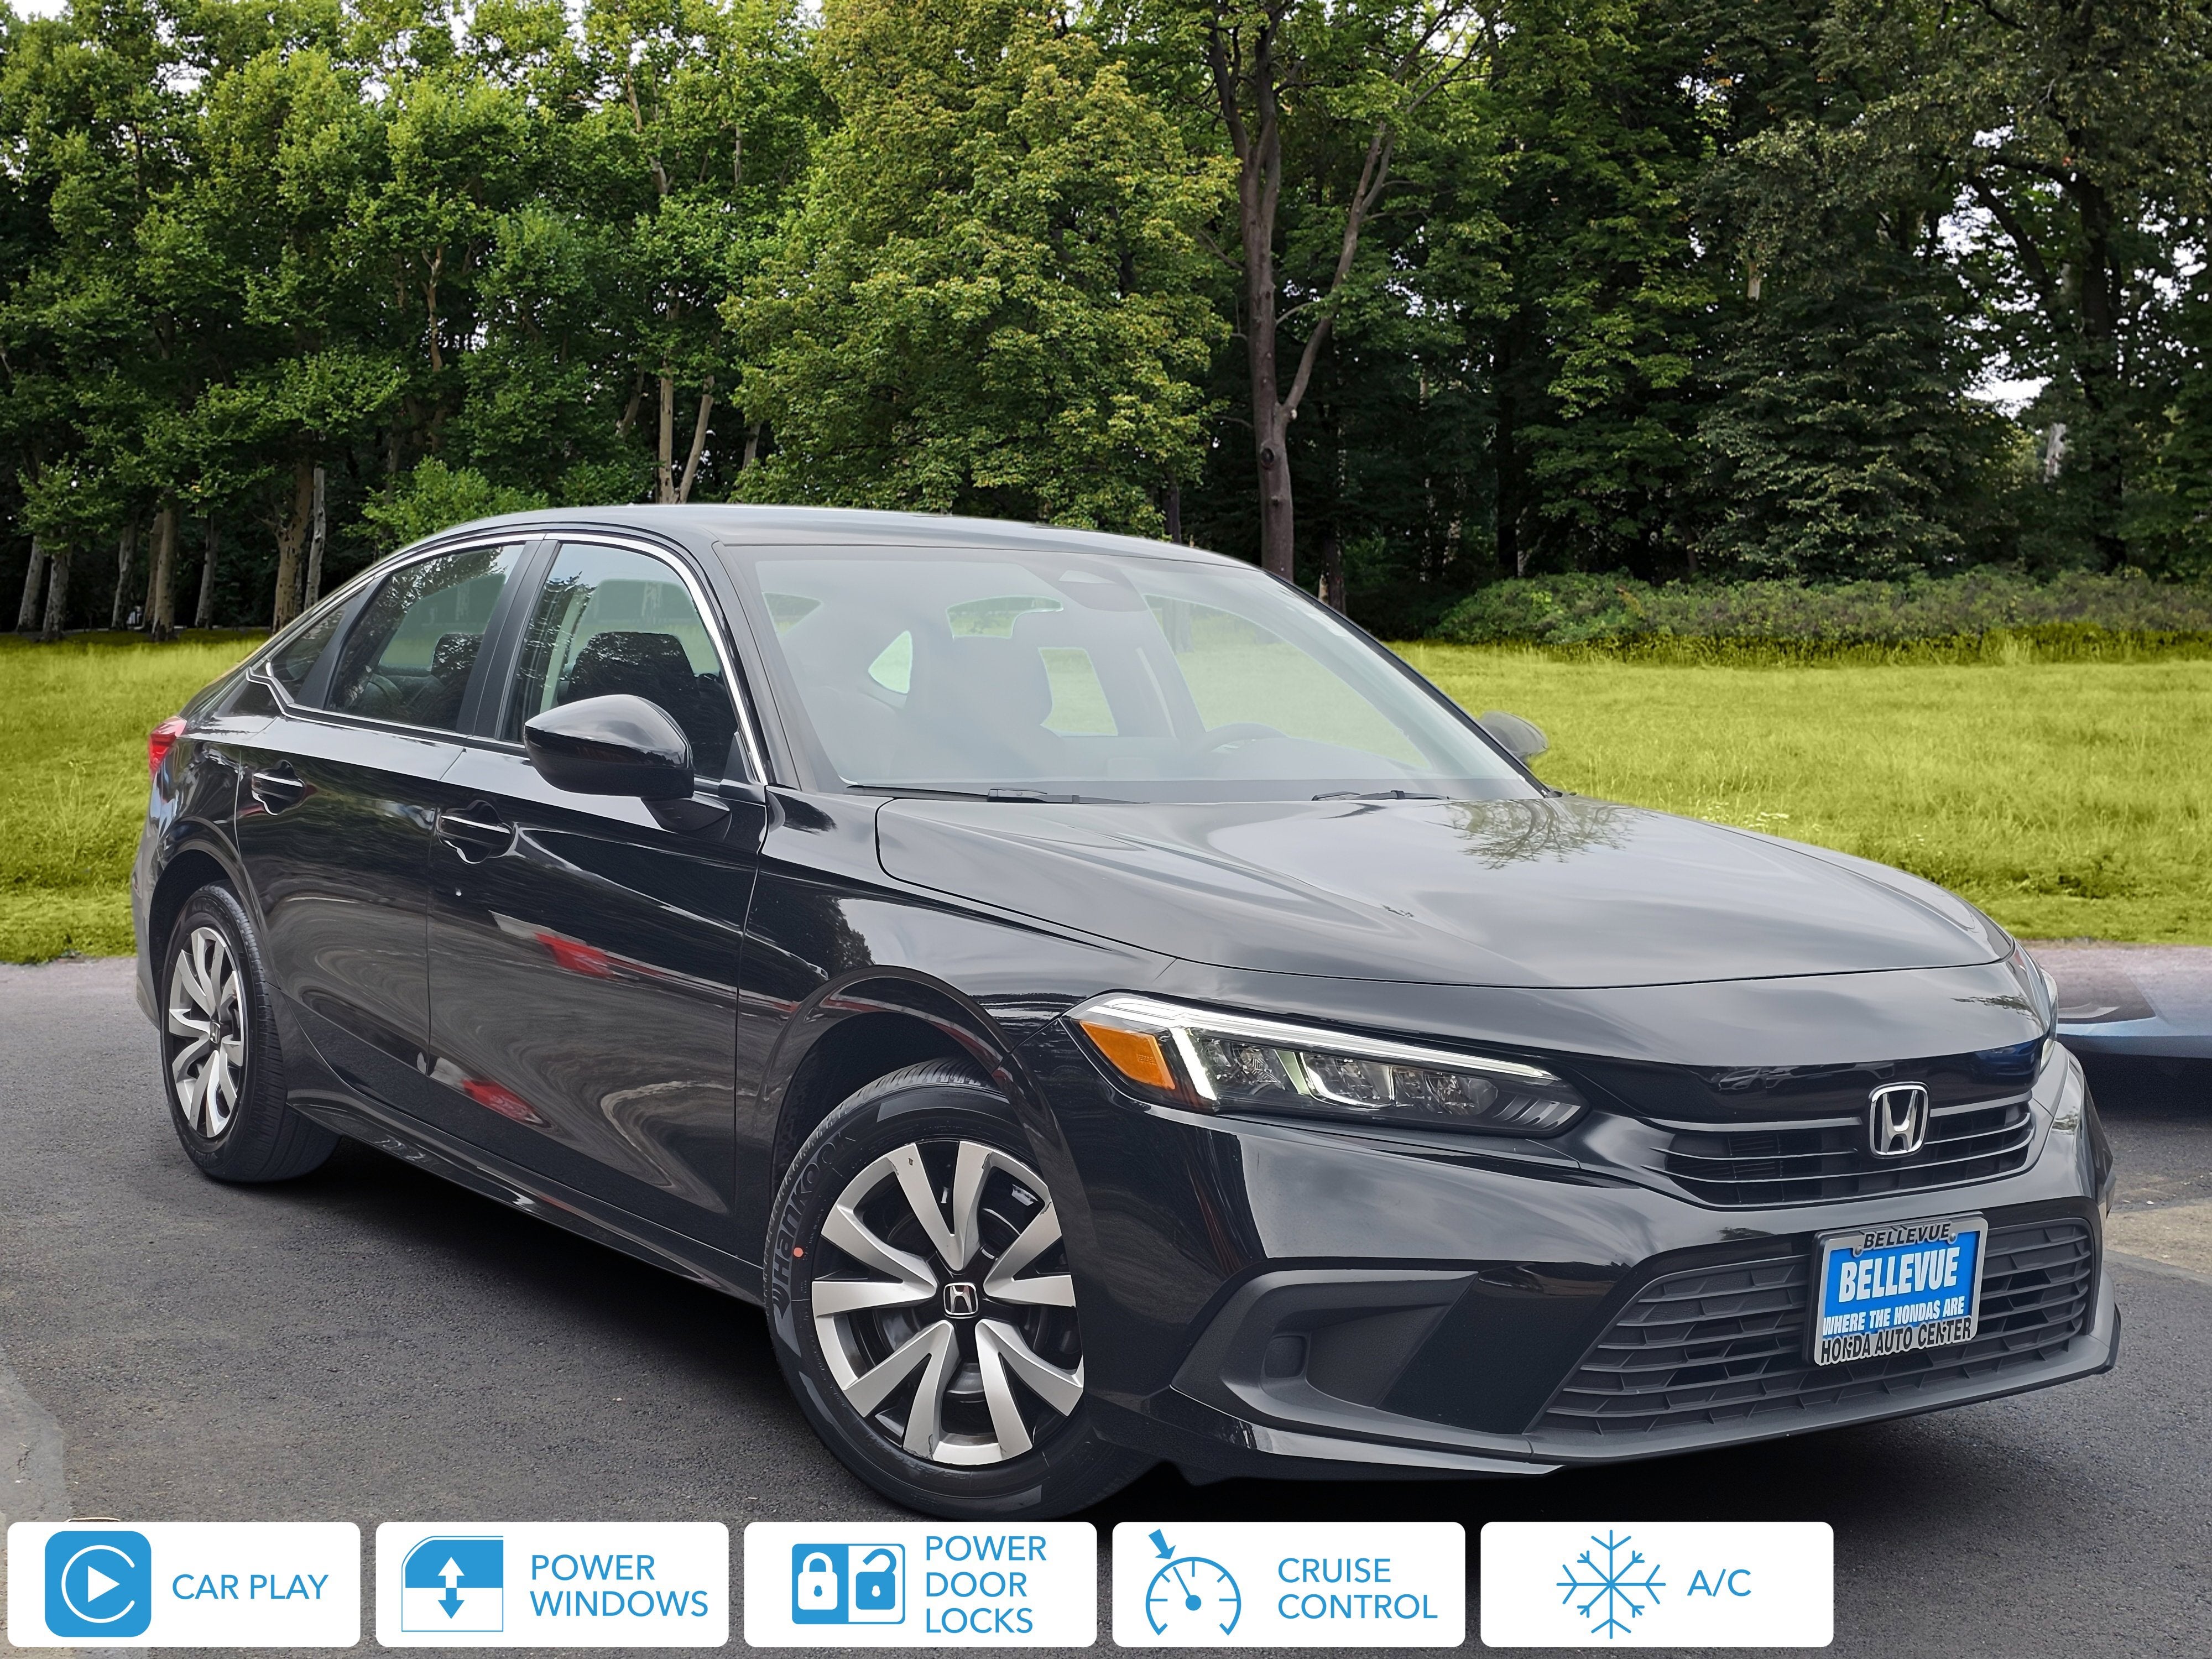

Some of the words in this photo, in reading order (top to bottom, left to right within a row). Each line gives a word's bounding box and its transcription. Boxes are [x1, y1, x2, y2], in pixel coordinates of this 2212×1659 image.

[1863, 1223, 1951, 1249] BELLEVUE
[1838, 1246, 1960, 1303] BELLEVUE
[1823, 1312, 1866, 1336] WHERE
[1869, 1308, 1891, 1329] THE
[1893, 1300, 1940, 1326] HONDAS
[1943, 1296, 1965, 1318] ARE
[1820, 1335, 1871, 1364] HONDA
[1875, 1326, 1913, 1355] AUTO
[1917, 1317, 1972, 1347] CENTER
